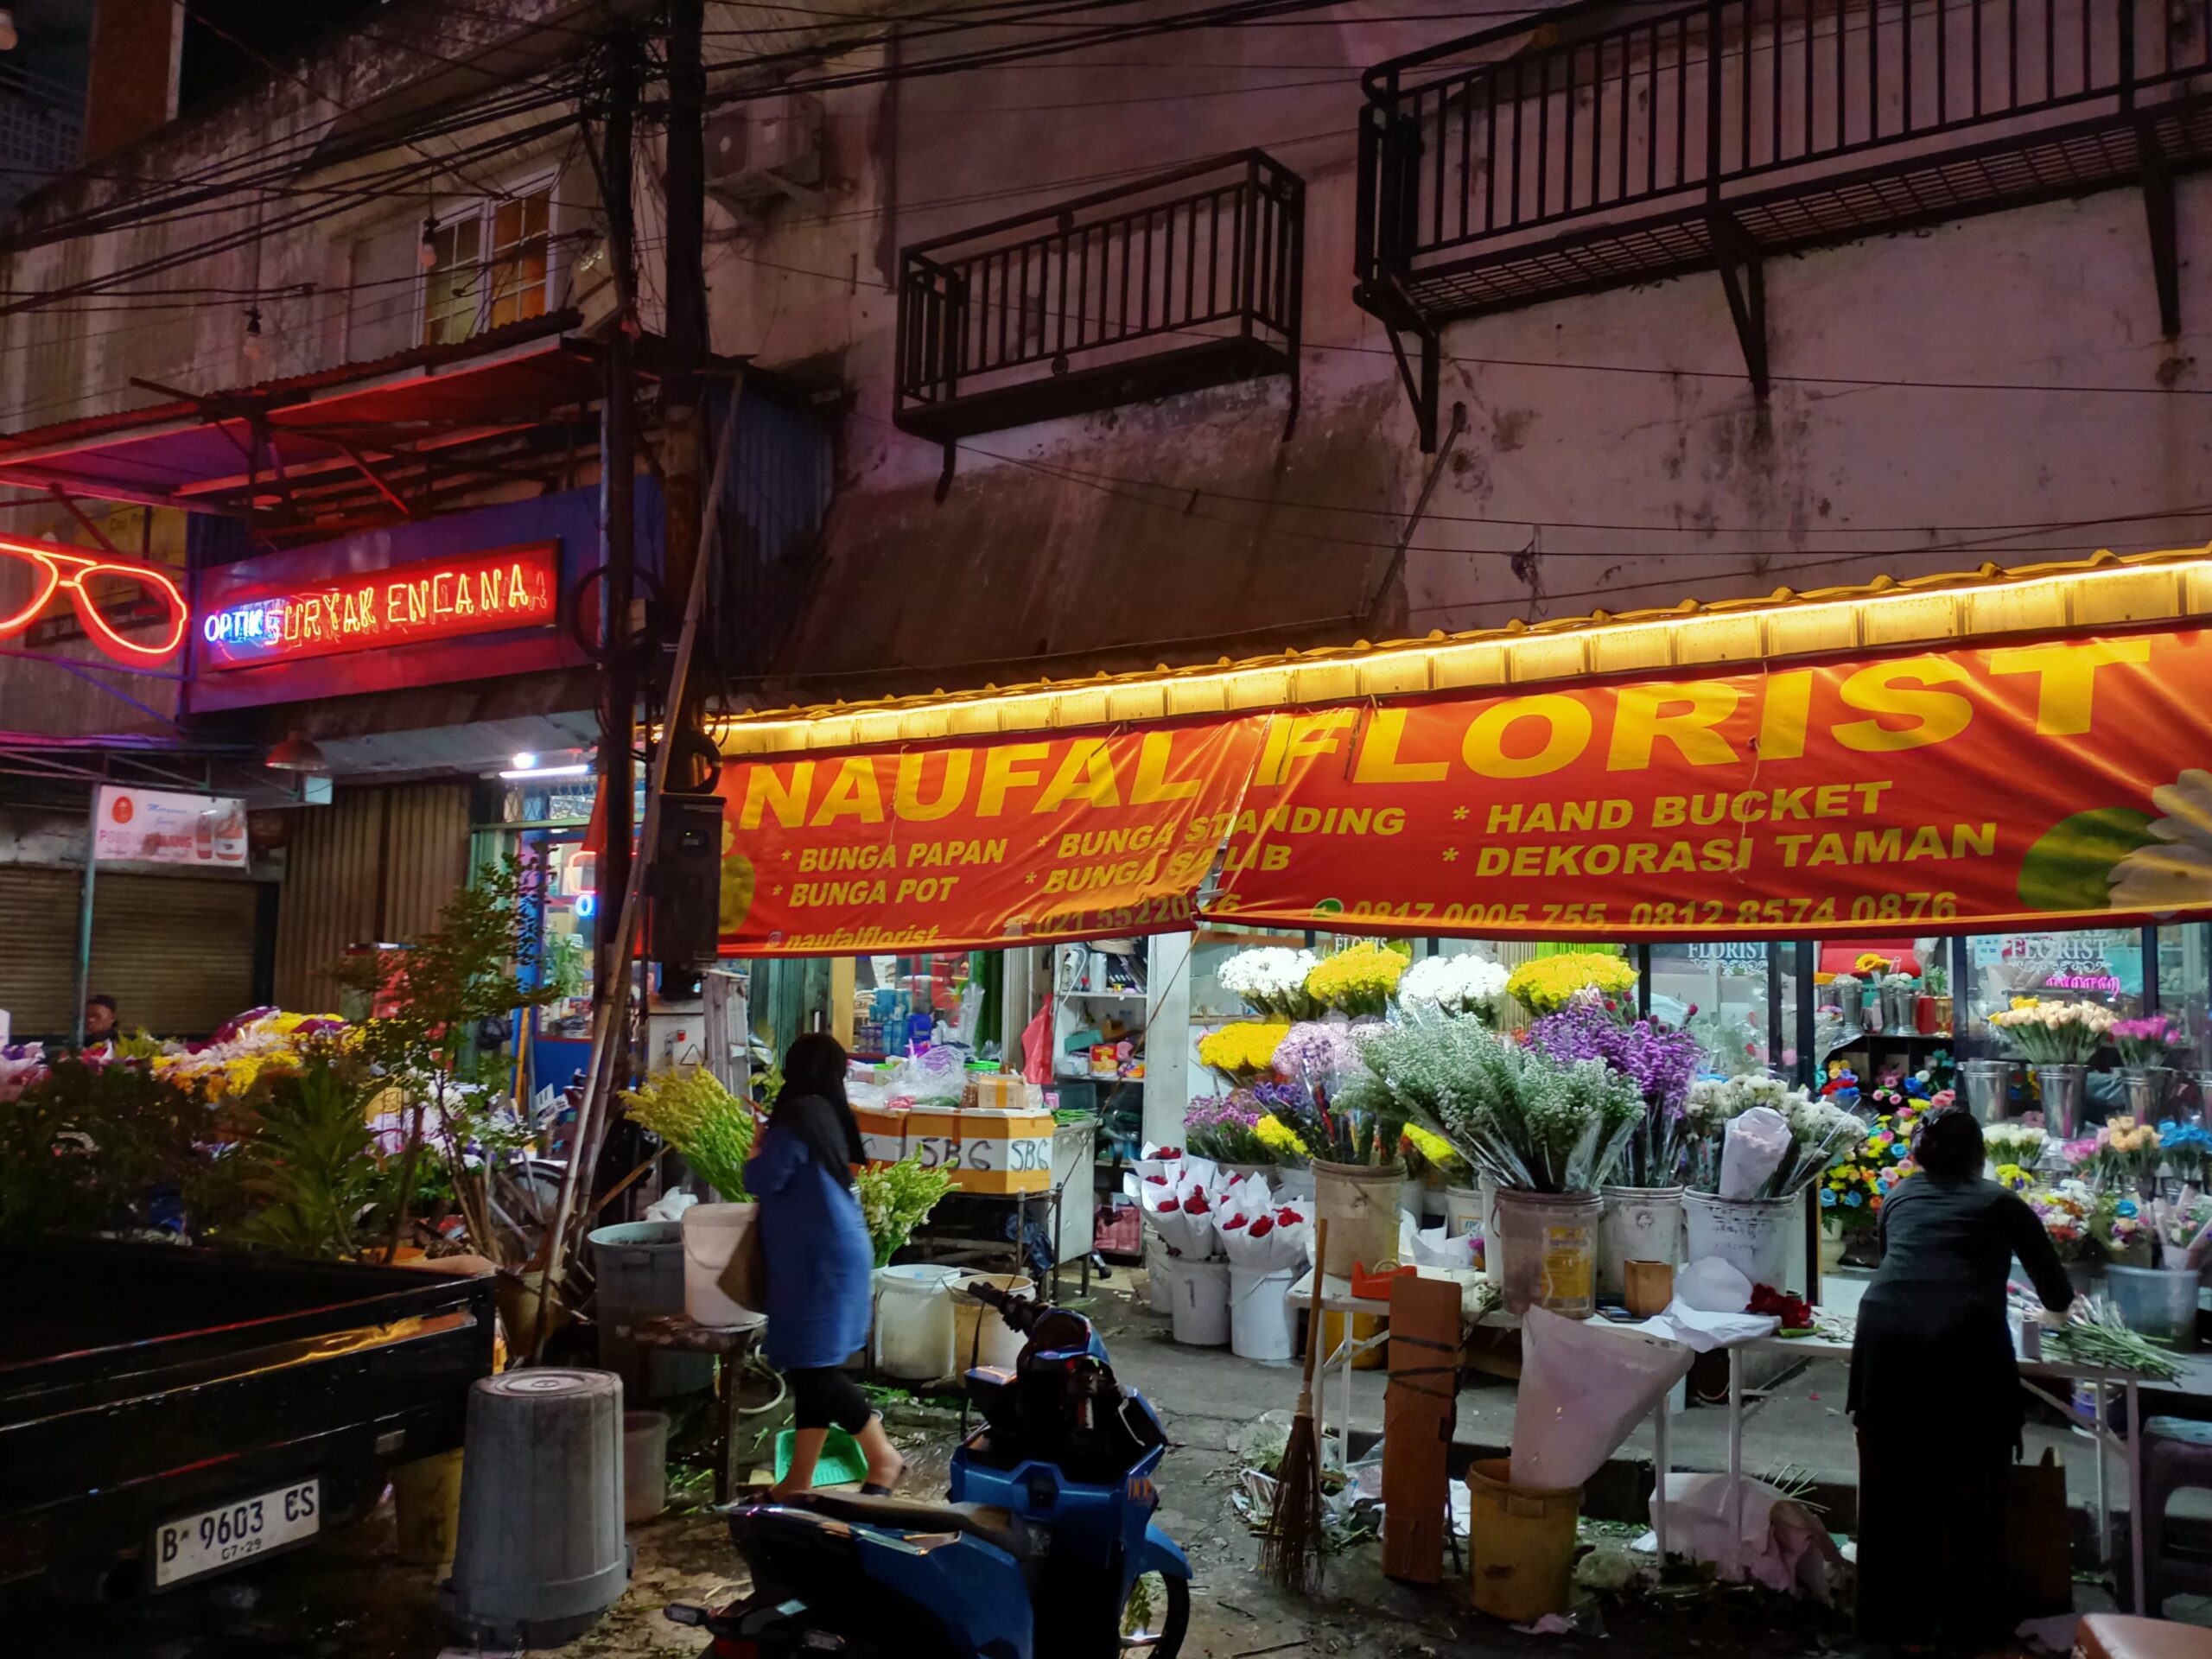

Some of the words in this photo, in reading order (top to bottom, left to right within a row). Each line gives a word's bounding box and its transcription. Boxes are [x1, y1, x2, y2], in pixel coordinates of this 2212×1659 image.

[203, 608, 263, 642] OPTIK
[739, 731, 1202, 830] NAUFAL
[1251, 639, 2152, 787] FLORIST
[1485, 799, 1633, 834] HAND
[1651, 780, 1892, 828] BUCKET
[1056, 822, 1176, 859] BUNGA
[1184, 804, 1407, 844] STANDING
[1474, 837, 1753, 877] DEKORASI
[1775, 823, 1997, 868] TAMAN
[798, 844, 897, 873] BUNGA
[906, 838, 1008, 868] PAPAN
[1043, 856, 1157, 894] BUNGA
[1168, 842, 1293, 878] SALIB
[788, 880, 887, 907] BUNGA
[895, 876, 959, 903] POT
[1440, 904, 1529, 929] 0005
[1629, 900, 1724, 930] 0812
[1735, 897, 1837, 928] 8574
[1850, 891, 1957, 925] 0876
[785, 924, 940, 950] naufalflorist
[1687, 942, 1768, 959] FLORIST
[2009, 938, 2110, 960] FLORIST
[162, 1528, 178, 1563] B
[200, 1500, 264, 1550] 9603
